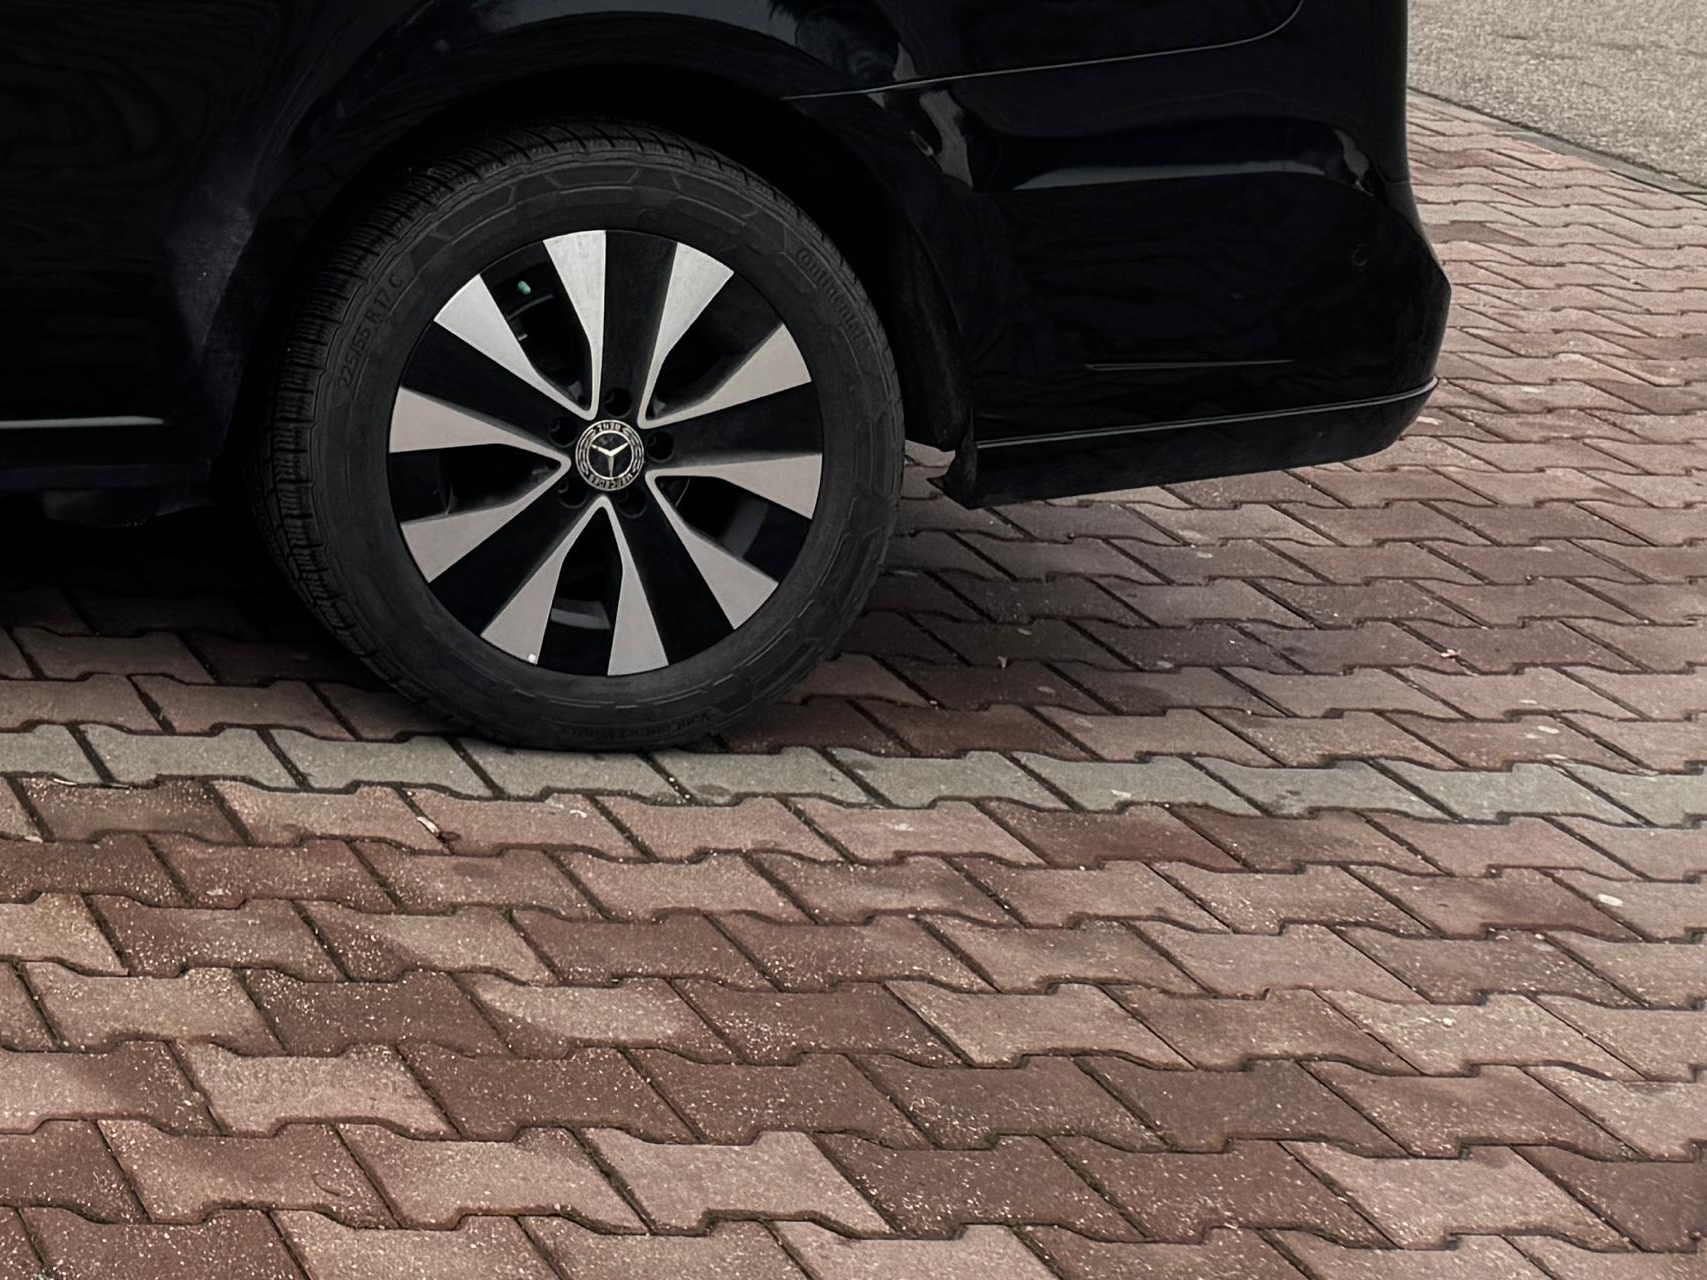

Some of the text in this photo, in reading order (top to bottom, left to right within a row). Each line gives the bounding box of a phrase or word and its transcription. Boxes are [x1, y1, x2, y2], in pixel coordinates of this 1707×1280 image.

[337, 324, 371, 386] 225/55
[364, 308, 382, 323] R
[374, 286, 392, 308] 17
